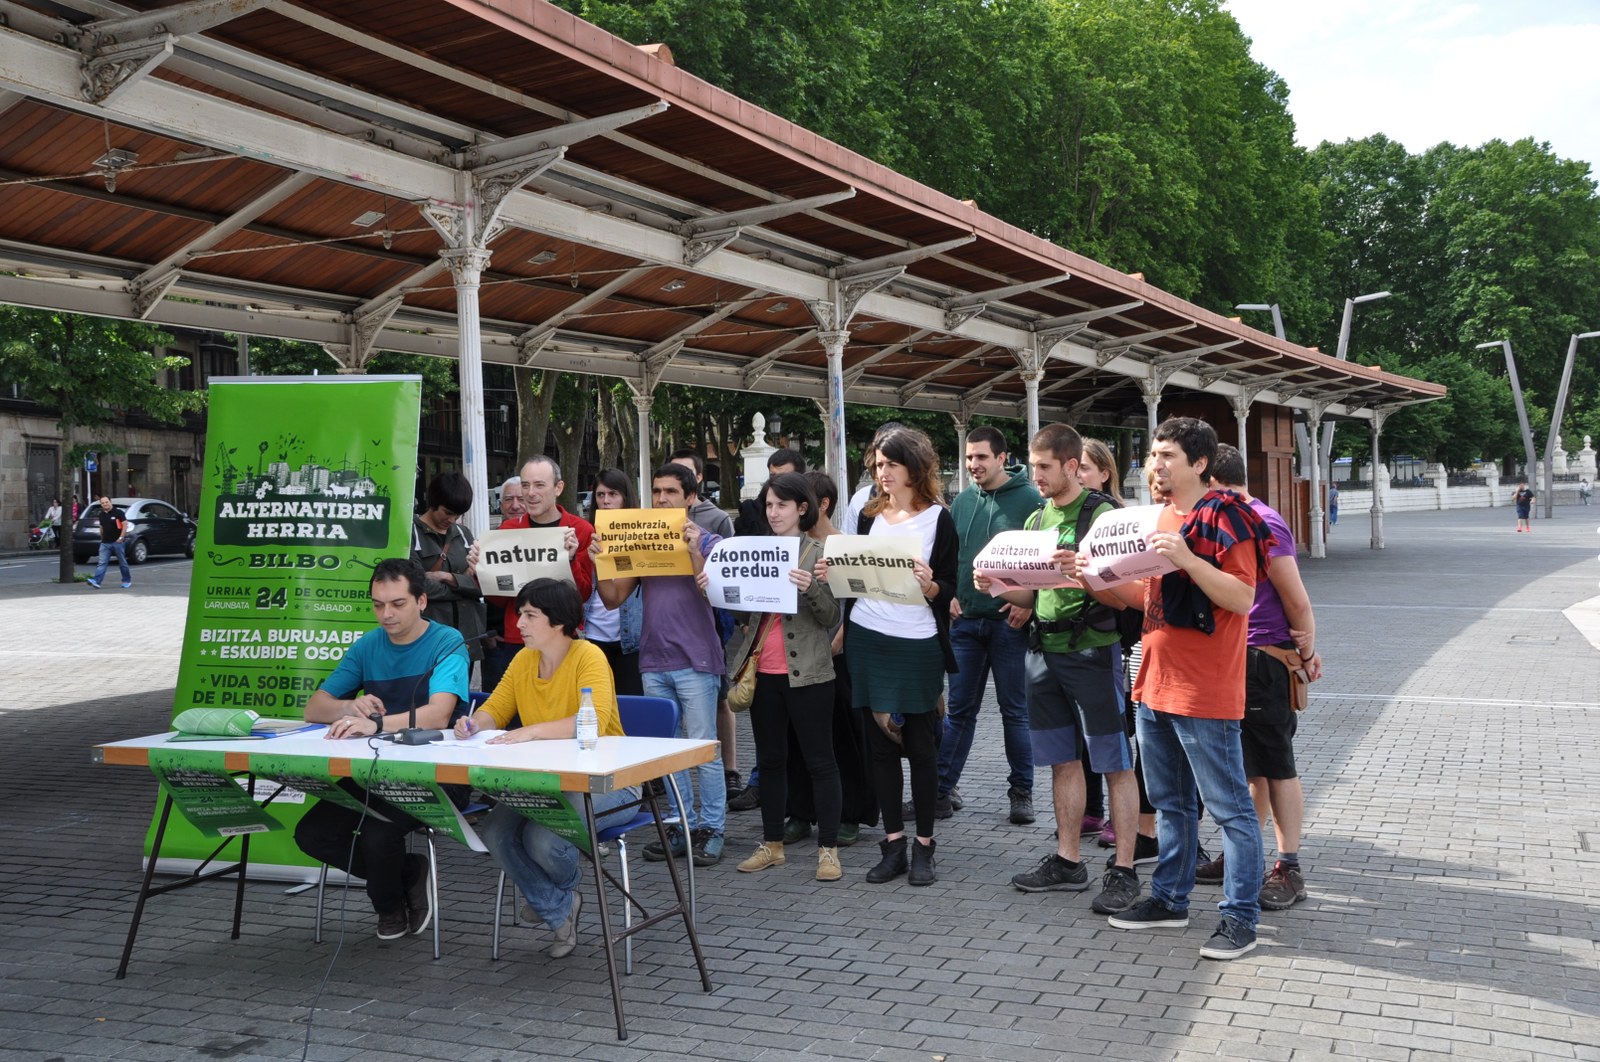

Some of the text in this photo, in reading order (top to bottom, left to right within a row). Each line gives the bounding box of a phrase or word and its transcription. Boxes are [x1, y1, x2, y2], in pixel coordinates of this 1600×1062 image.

[219, 502, 385, 520] ALTERNATIBEN
[247, 523, 348, 540] HERRIA
[609, 520, 670, 530] demokrazia,
[1094, 521, 1140, 539] ondare
[601, 531, 680, 542] burujabetza eta
[485, 545, 558, 565] natura
[608, 542, 674, 554] partehartzea
[710, 546, 789, 563] ekonomia
[991, 545, 1040, 556] bizitzaren
[1090, 538, 1147, 558] komuna
[248, 553, 341, 571] BILBO
[826, 553, 915, 569] aniztasuna
[976, 558, 1056, 571] iraunkortasuna
[721, 562, 779, 578] eredua
[207, 586, 372, 610] URRIAK 24 DE OCTUBRE
[204, 601, 352, 613] LARUNBATA SÁBADO
[200, 629, 262, 643] BIZITZA
[220, 645, 350, 661] ESKUBIDE OSO
[210, 674, 250, 689] VIDA
[192, 690, 312, 708] DE PLENO DE
